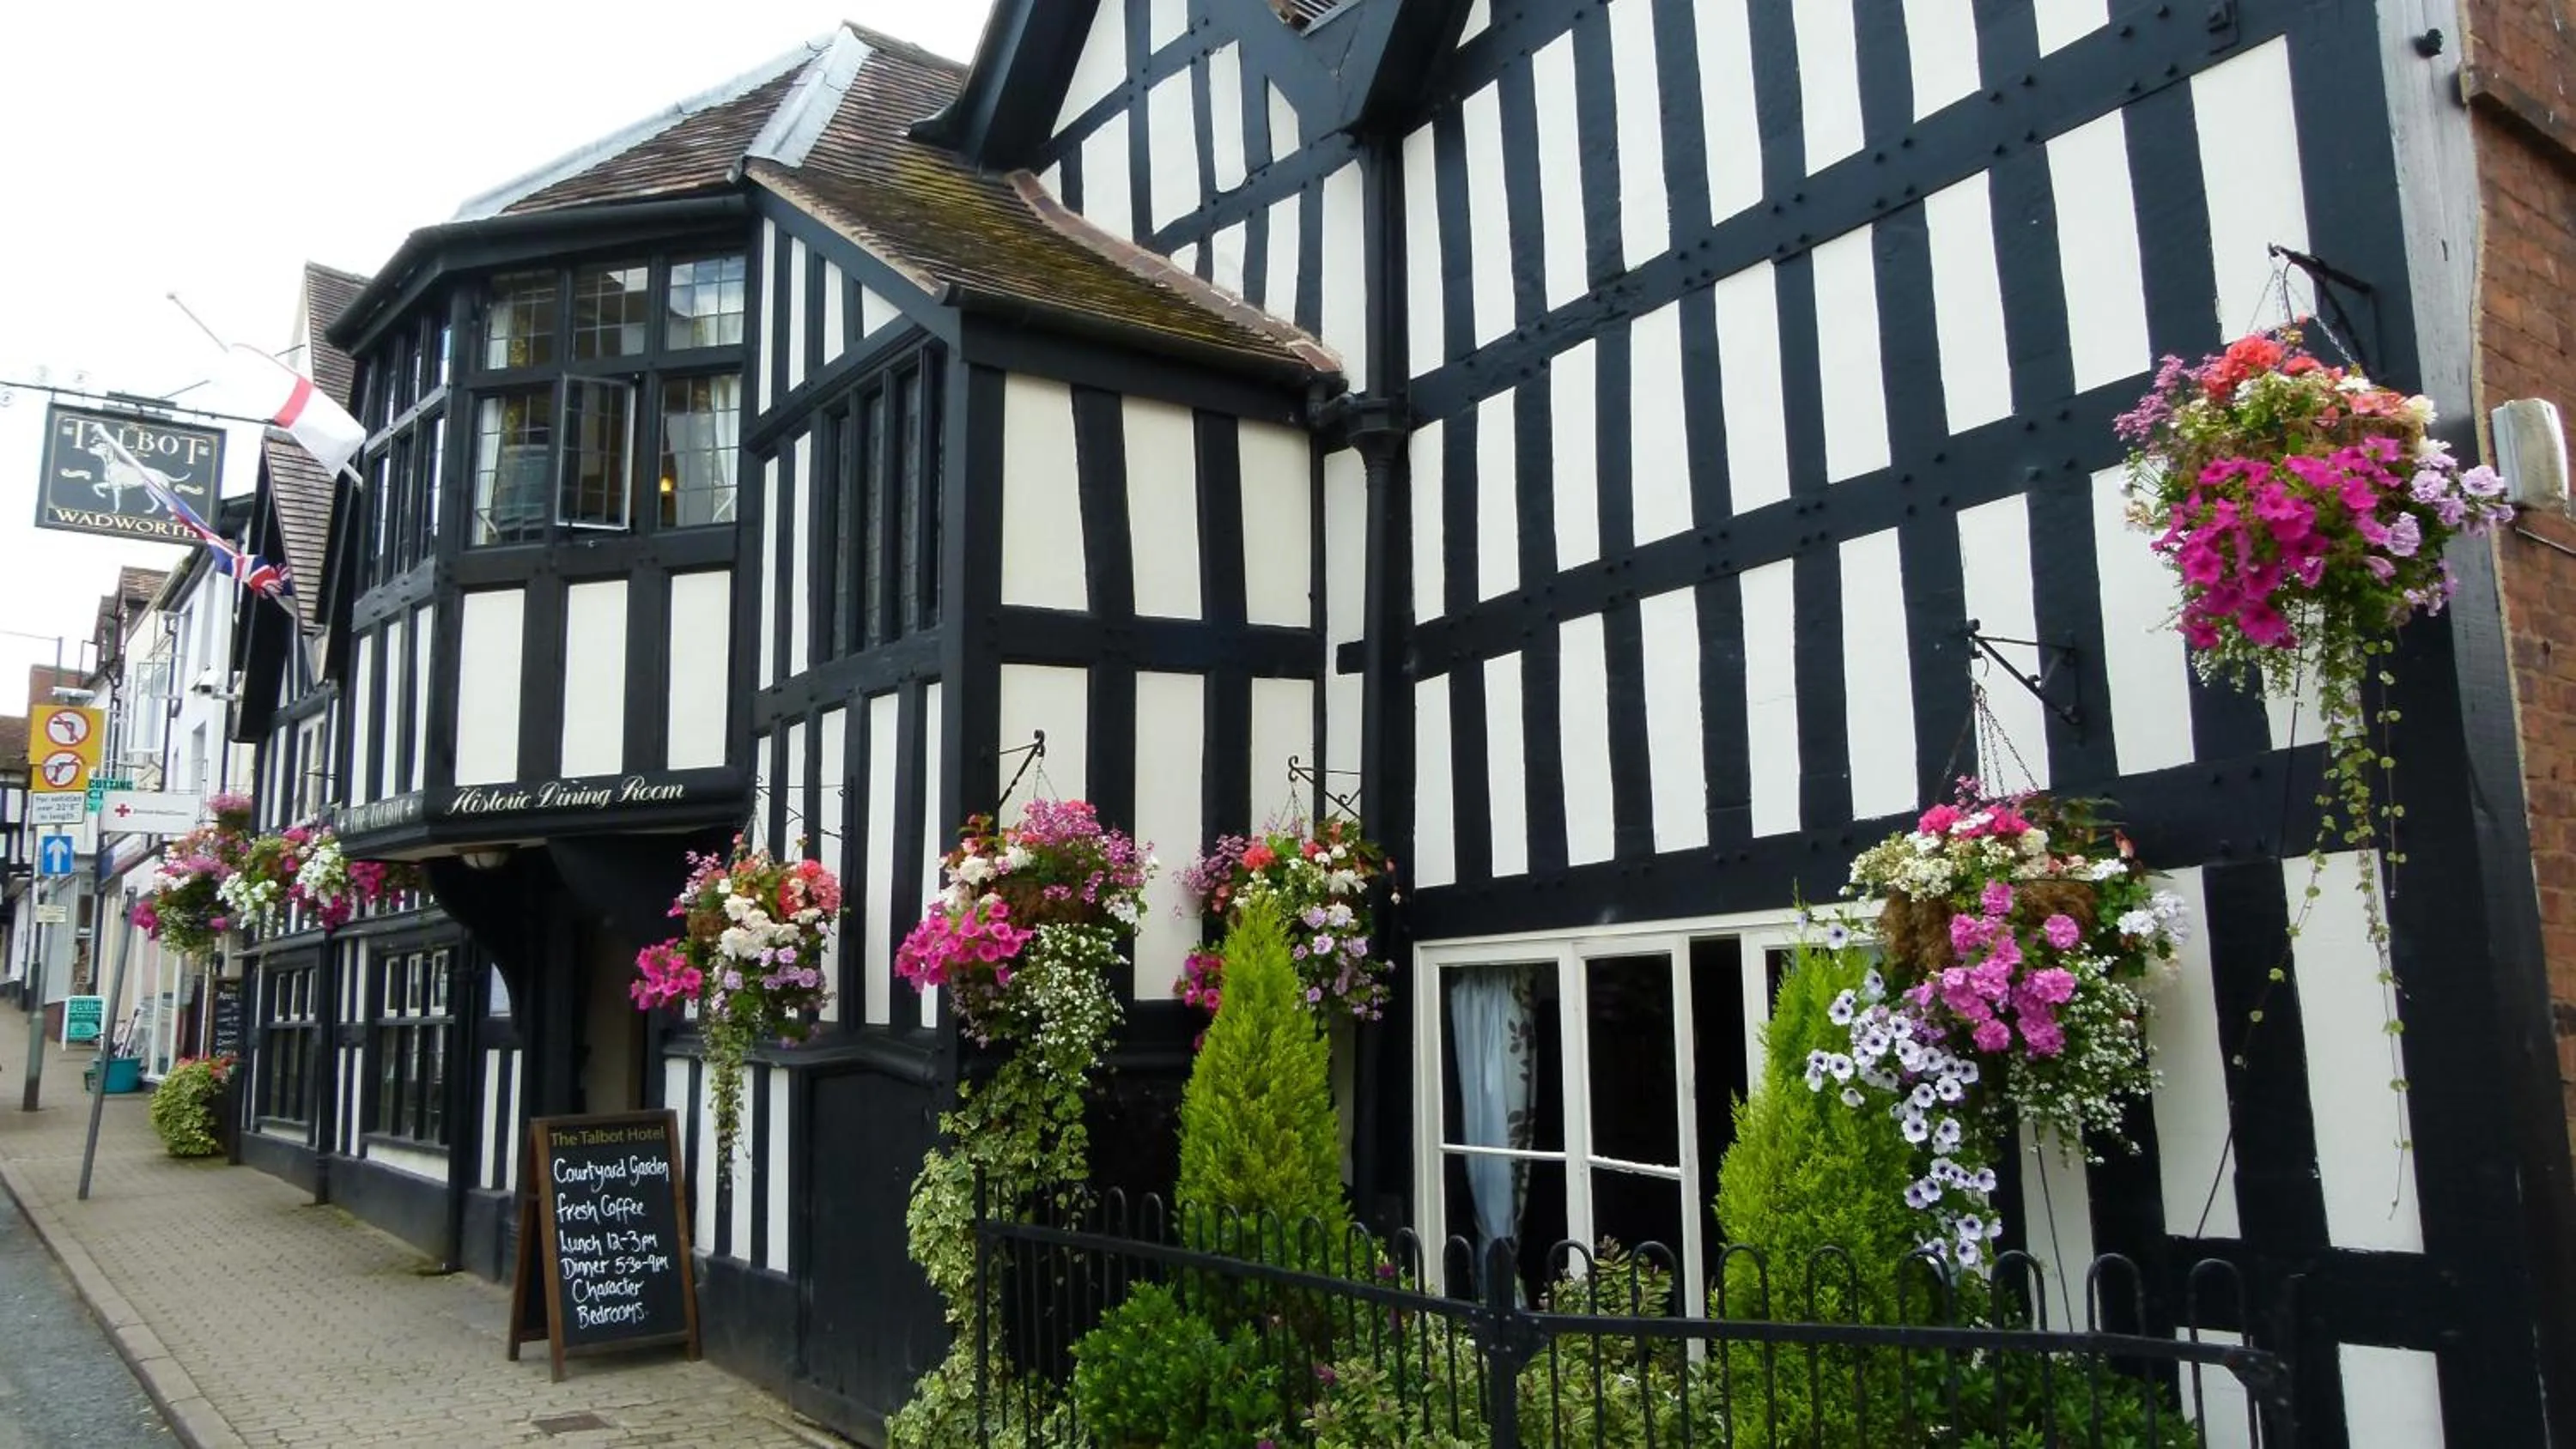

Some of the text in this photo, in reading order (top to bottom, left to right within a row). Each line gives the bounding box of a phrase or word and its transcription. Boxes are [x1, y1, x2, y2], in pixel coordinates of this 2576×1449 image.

[55, 507, 198, 538] WADWORTH
[446, 774, 685, 815] Historic Dining Room
[552, 1125, 665, 1147] The Talbot Hotel
[554, 1155, 669, 1193] Courtyard Garden
[601, 1194, 646, 1225] Coffee
[559, 1229, 603, 1257] Lunch
[561, 1258, 610, 1280] Dinner
[572, 1277, 645, 1303] Character
